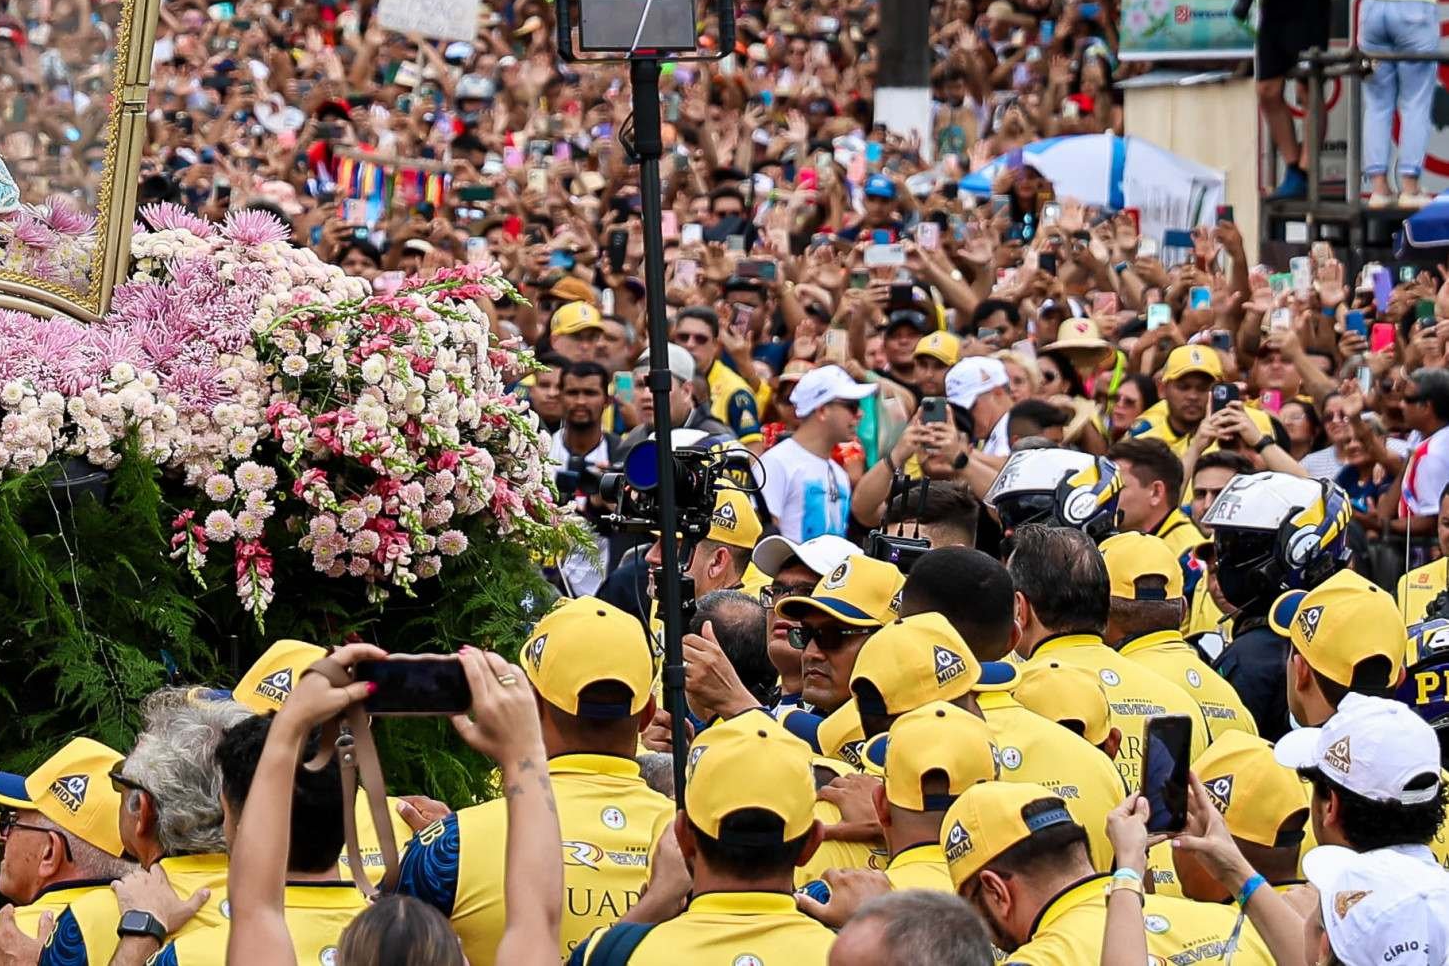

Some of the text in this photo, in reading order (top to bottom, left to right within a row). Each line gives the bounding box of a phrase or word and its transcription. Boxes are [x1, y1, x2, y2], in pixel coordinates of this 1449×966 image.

[937, 661, 966, 684] MIDAS
[1324, 751, 1350, 774] MIDAS
[49, 781, 81, 812] MIDAS
[946, 840, 973, 862] MIDAS
[1384, 940, 1419, 963] CÍRIO
